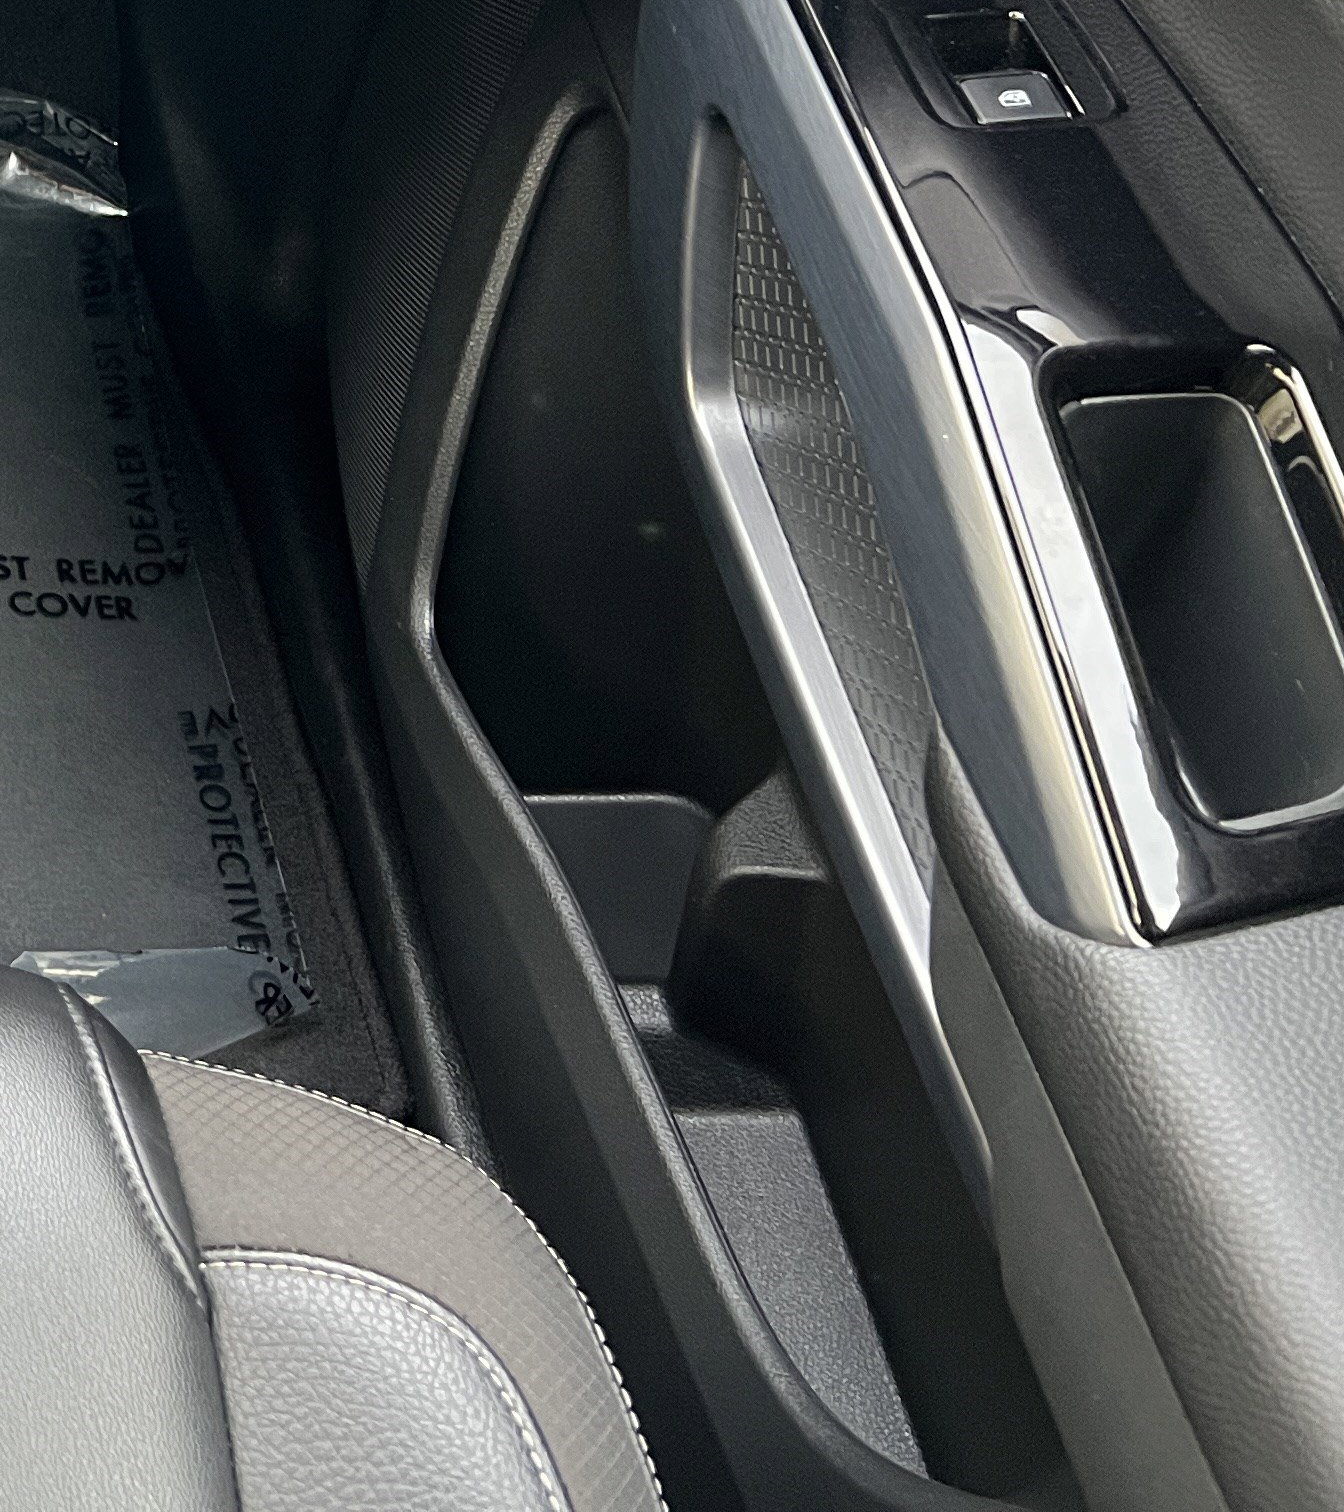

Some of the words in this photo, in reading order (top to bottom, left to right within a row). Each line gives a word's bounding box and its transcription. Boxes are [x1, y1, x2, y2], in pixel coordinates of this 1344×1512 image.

[92, 339, 136, 422] MUST
[115, 443, 168, 558] DEALER
[10, 591, 138, 624] COVER
[187, 742, 273, 958] PROTECTIVE
